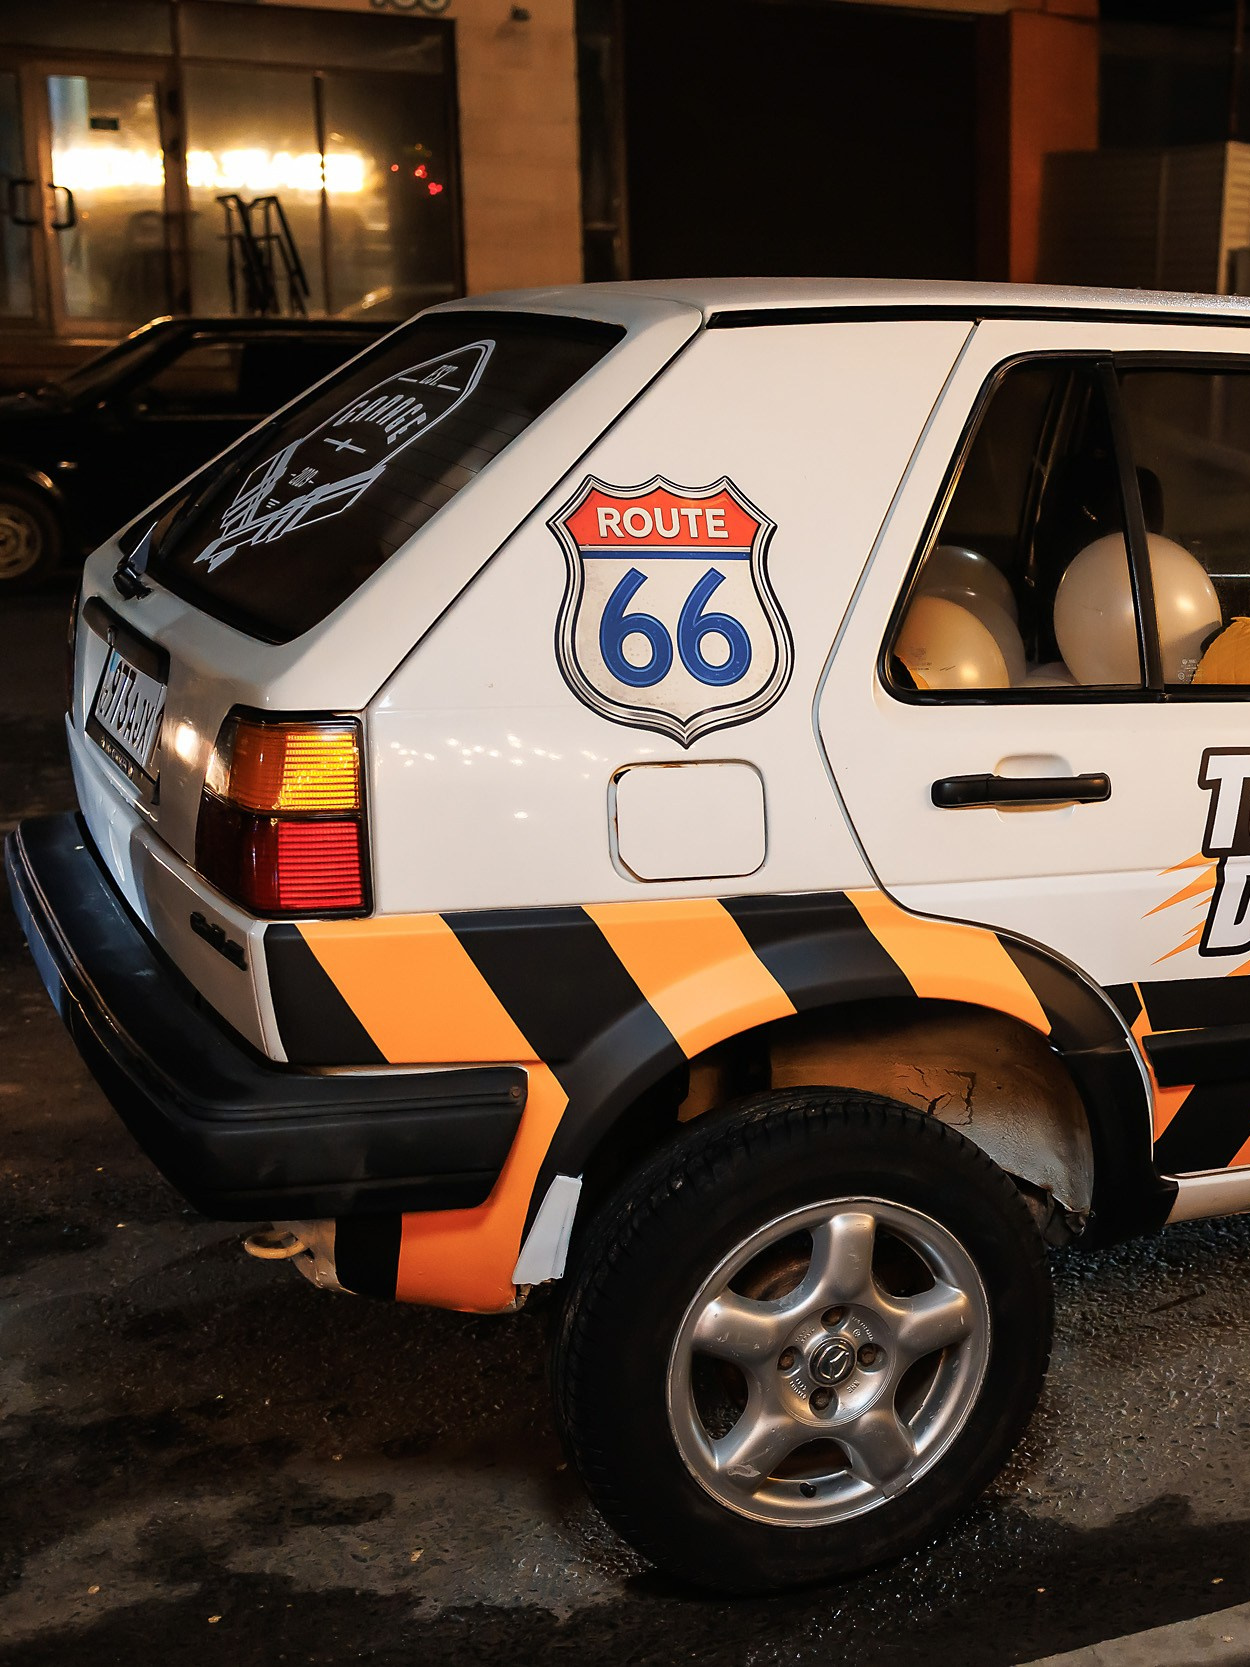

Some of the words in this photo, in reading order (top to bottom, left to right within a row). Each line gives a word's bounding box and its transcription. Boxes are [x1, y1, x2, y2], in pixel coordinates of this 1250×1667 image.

[332, 394, 427, 445] GARAGE
[596, 506, 730, 540] ROUTE
[599, 566, 752, 688] 66
